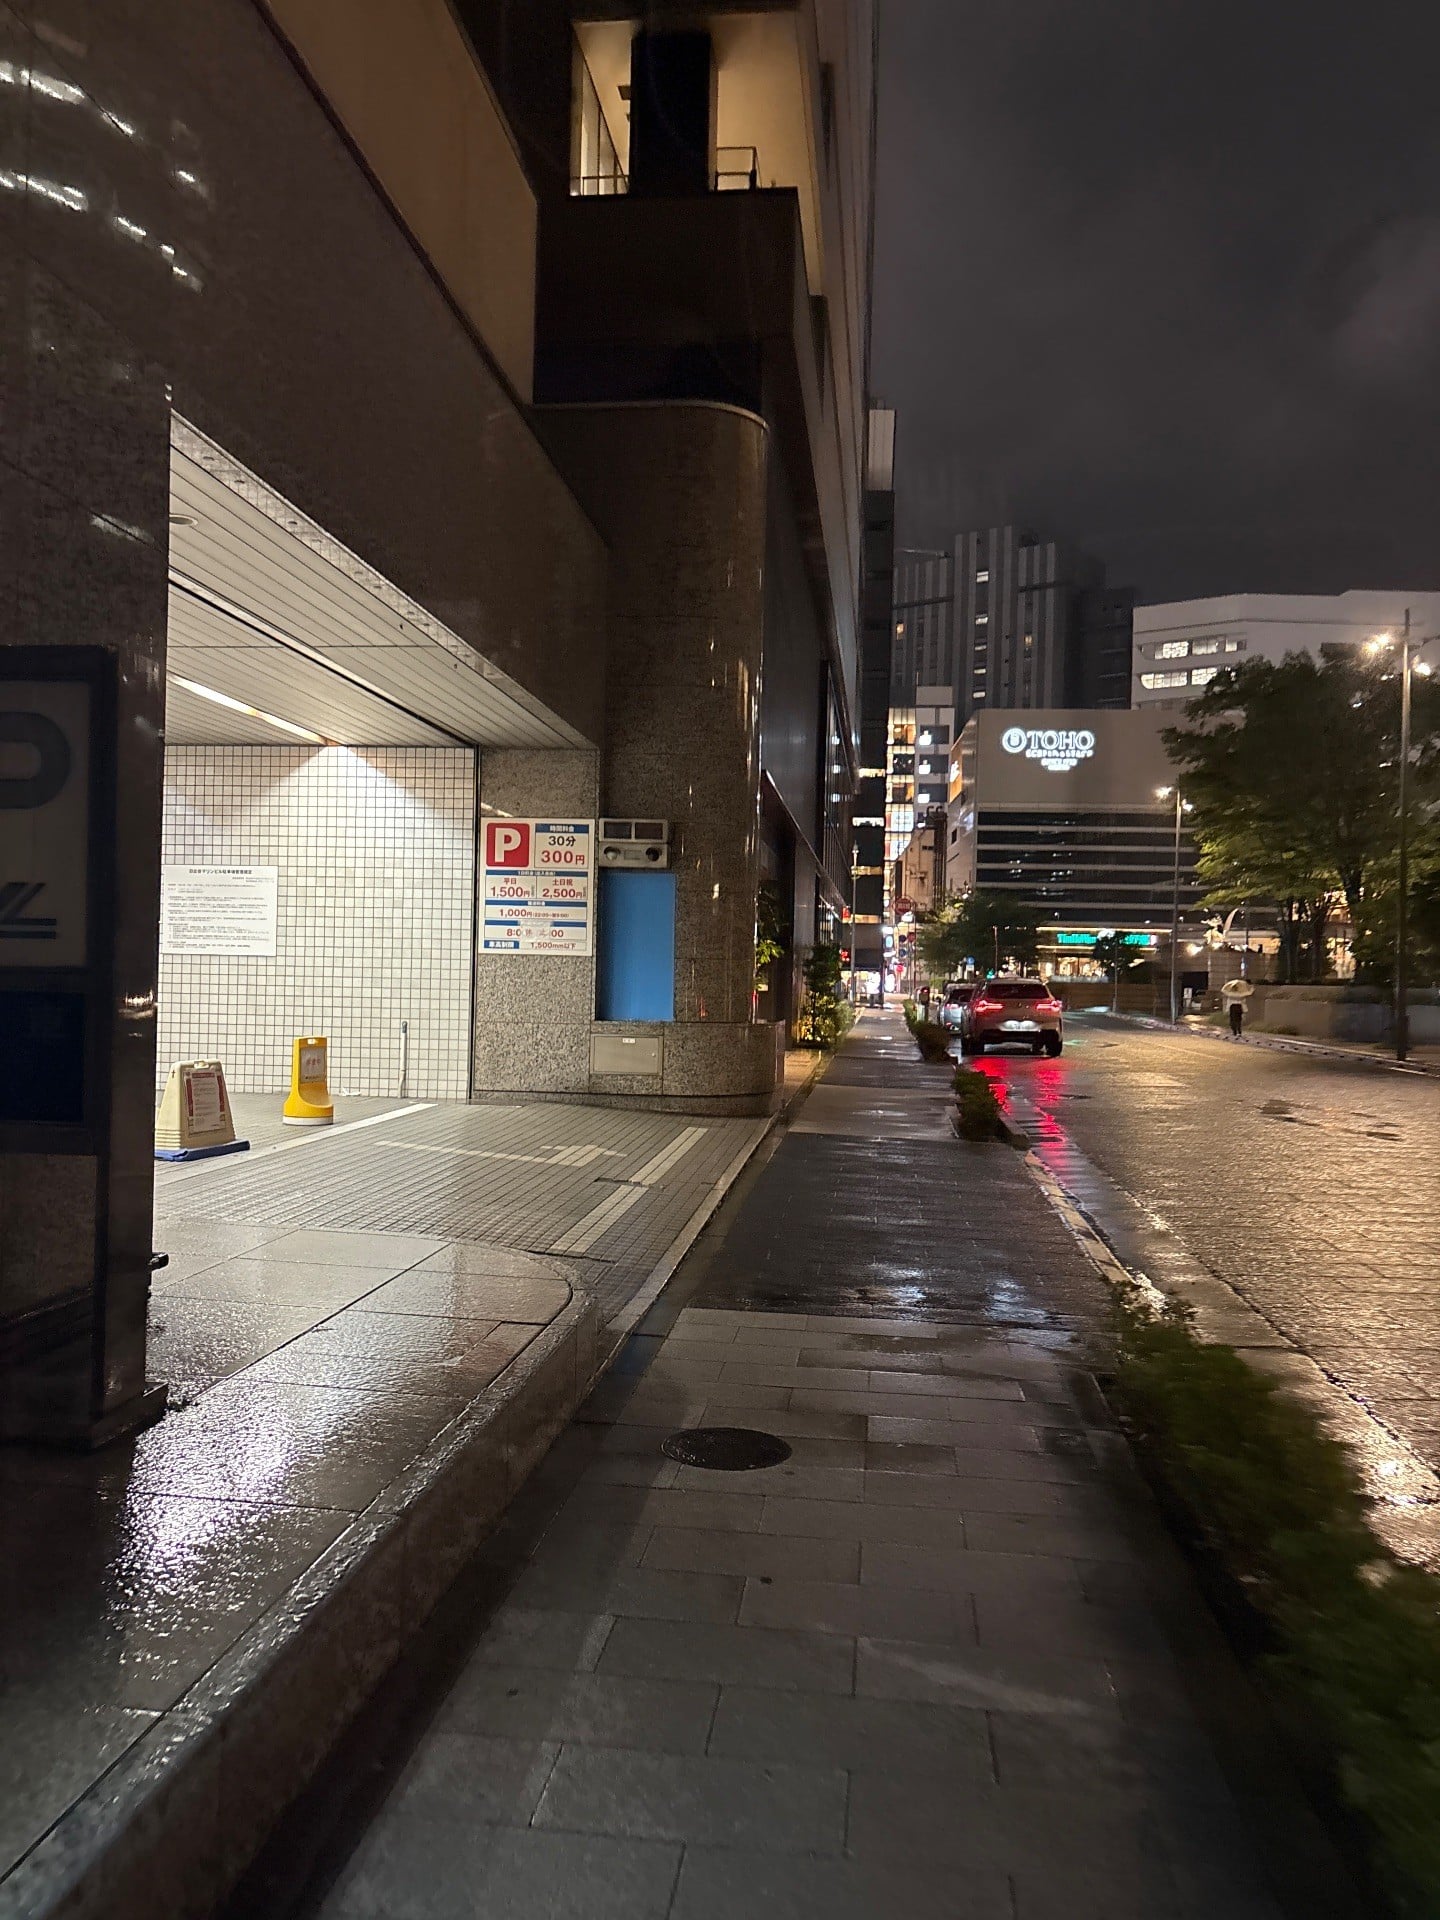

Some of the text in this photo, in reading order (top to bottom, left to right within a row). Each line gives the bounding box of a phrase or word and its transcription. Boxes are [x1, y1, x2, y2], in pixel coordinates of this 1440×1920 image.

[1026, 730, 1095, 750] TOHO
[494, 827, 522, 863] P
[548, 835, 576, 847] 30分
[541, 850, 585, 865] 300円
[504, 877, 517, 885] 平日
[552, 878, 573, 886] 土日祝
[490, 886, 530, 898] 1,500円
[542, 888, 583, 899] 2,500円
[499, 908, 532, 917] 1,000円
